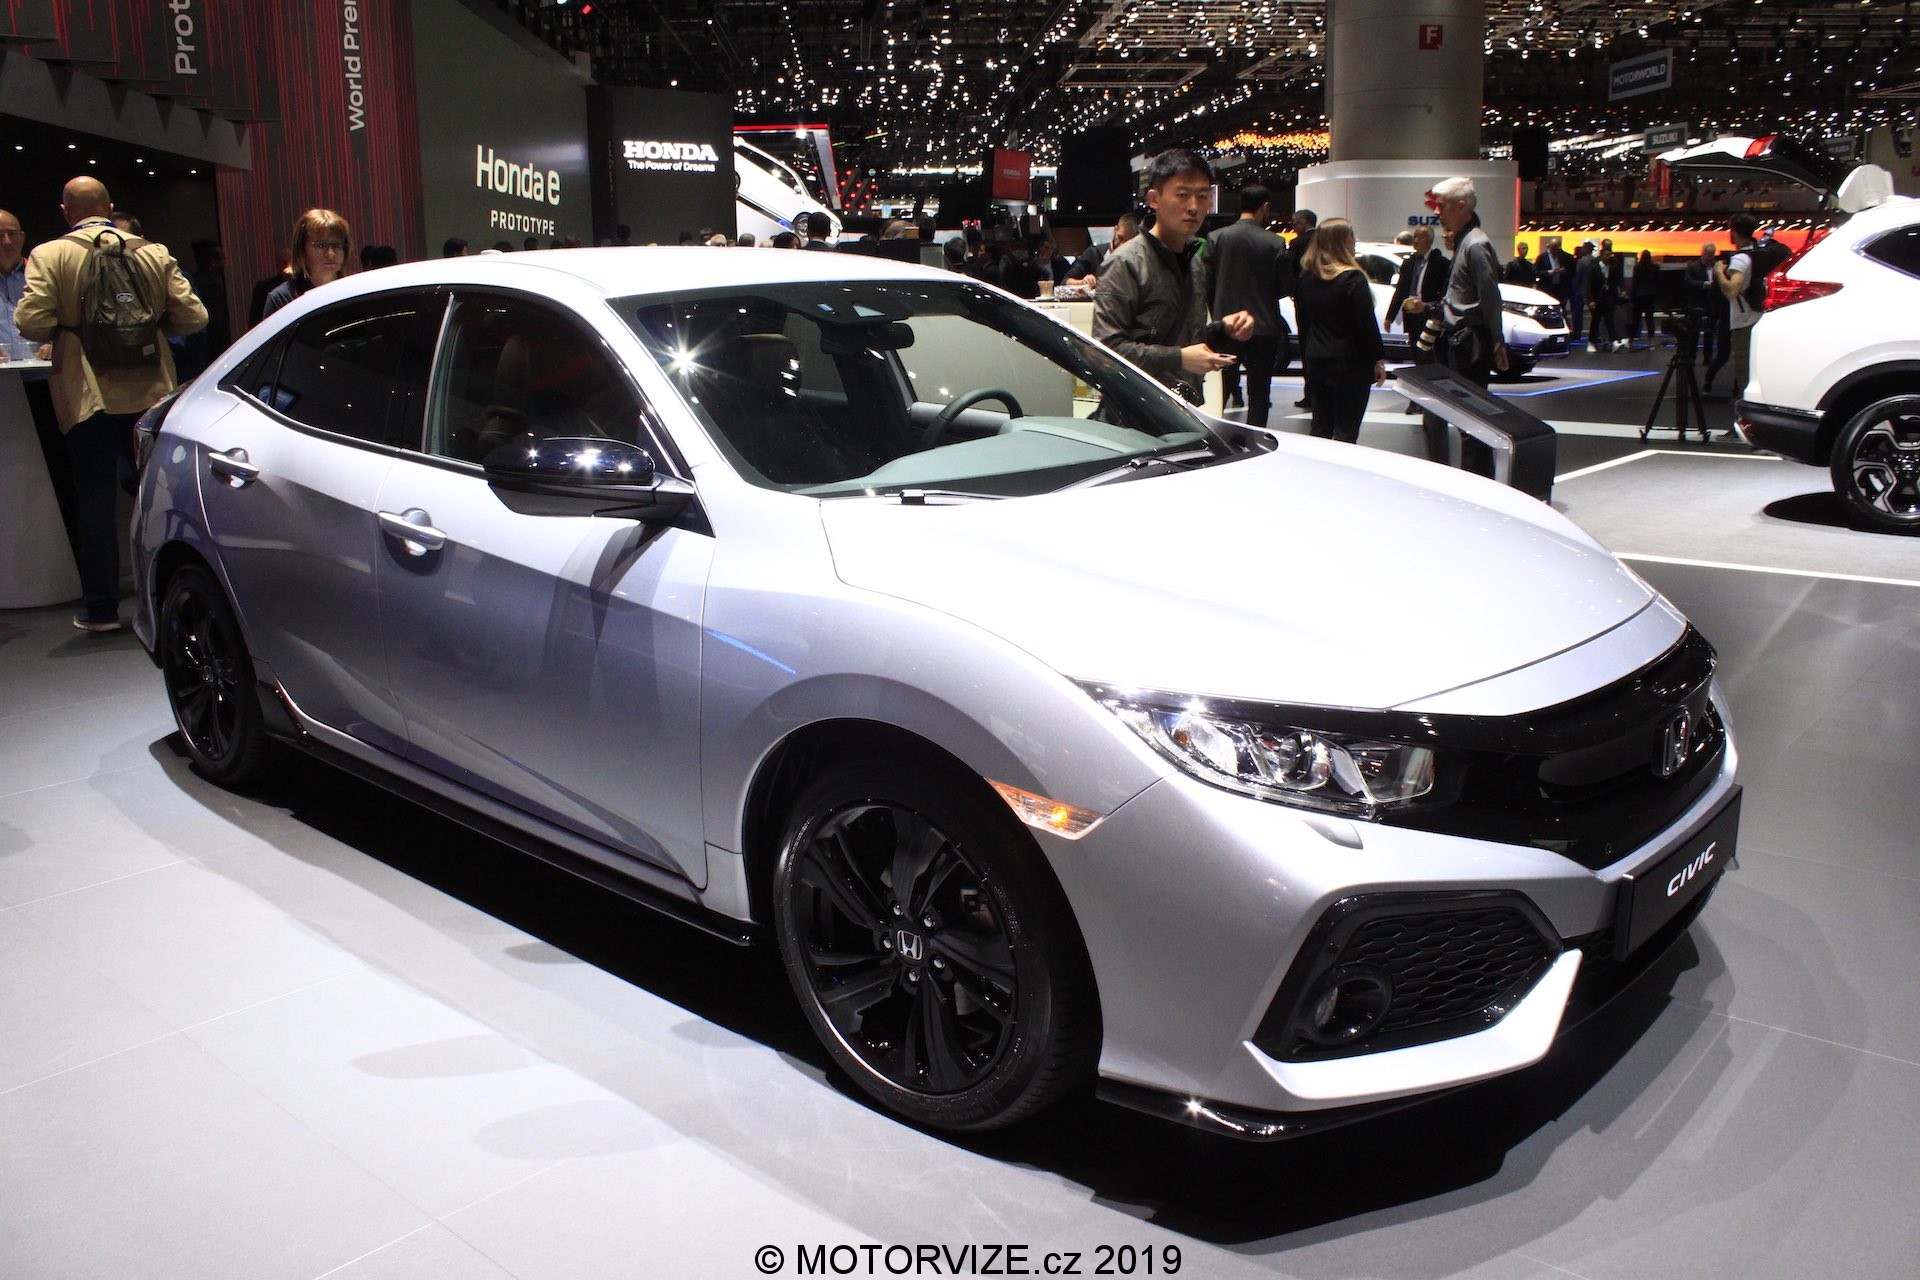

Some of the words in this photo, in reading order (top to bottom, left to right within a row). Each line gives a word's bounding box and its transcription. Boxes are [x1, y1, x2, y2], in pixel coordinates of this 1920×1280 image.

[1426, 26, 1439, 44] F
[1613, 63, 1667, 87] MOTORWORLD
[344, 56, 366, 131] World
[622, 140, 719, 161] HONDA
[476, 144, 545, 203] Honda
[547, 169, 561, 206] e
[627, 160, 645, 170] The
[645, 160, 673, 171] Power
[672, 161, 683, 171] of
[683, 162, 716, 172] Dreams
[490, 209, 555, 236] PROTOTYPE
[1667, 841, 1716, 896] CIVIC
